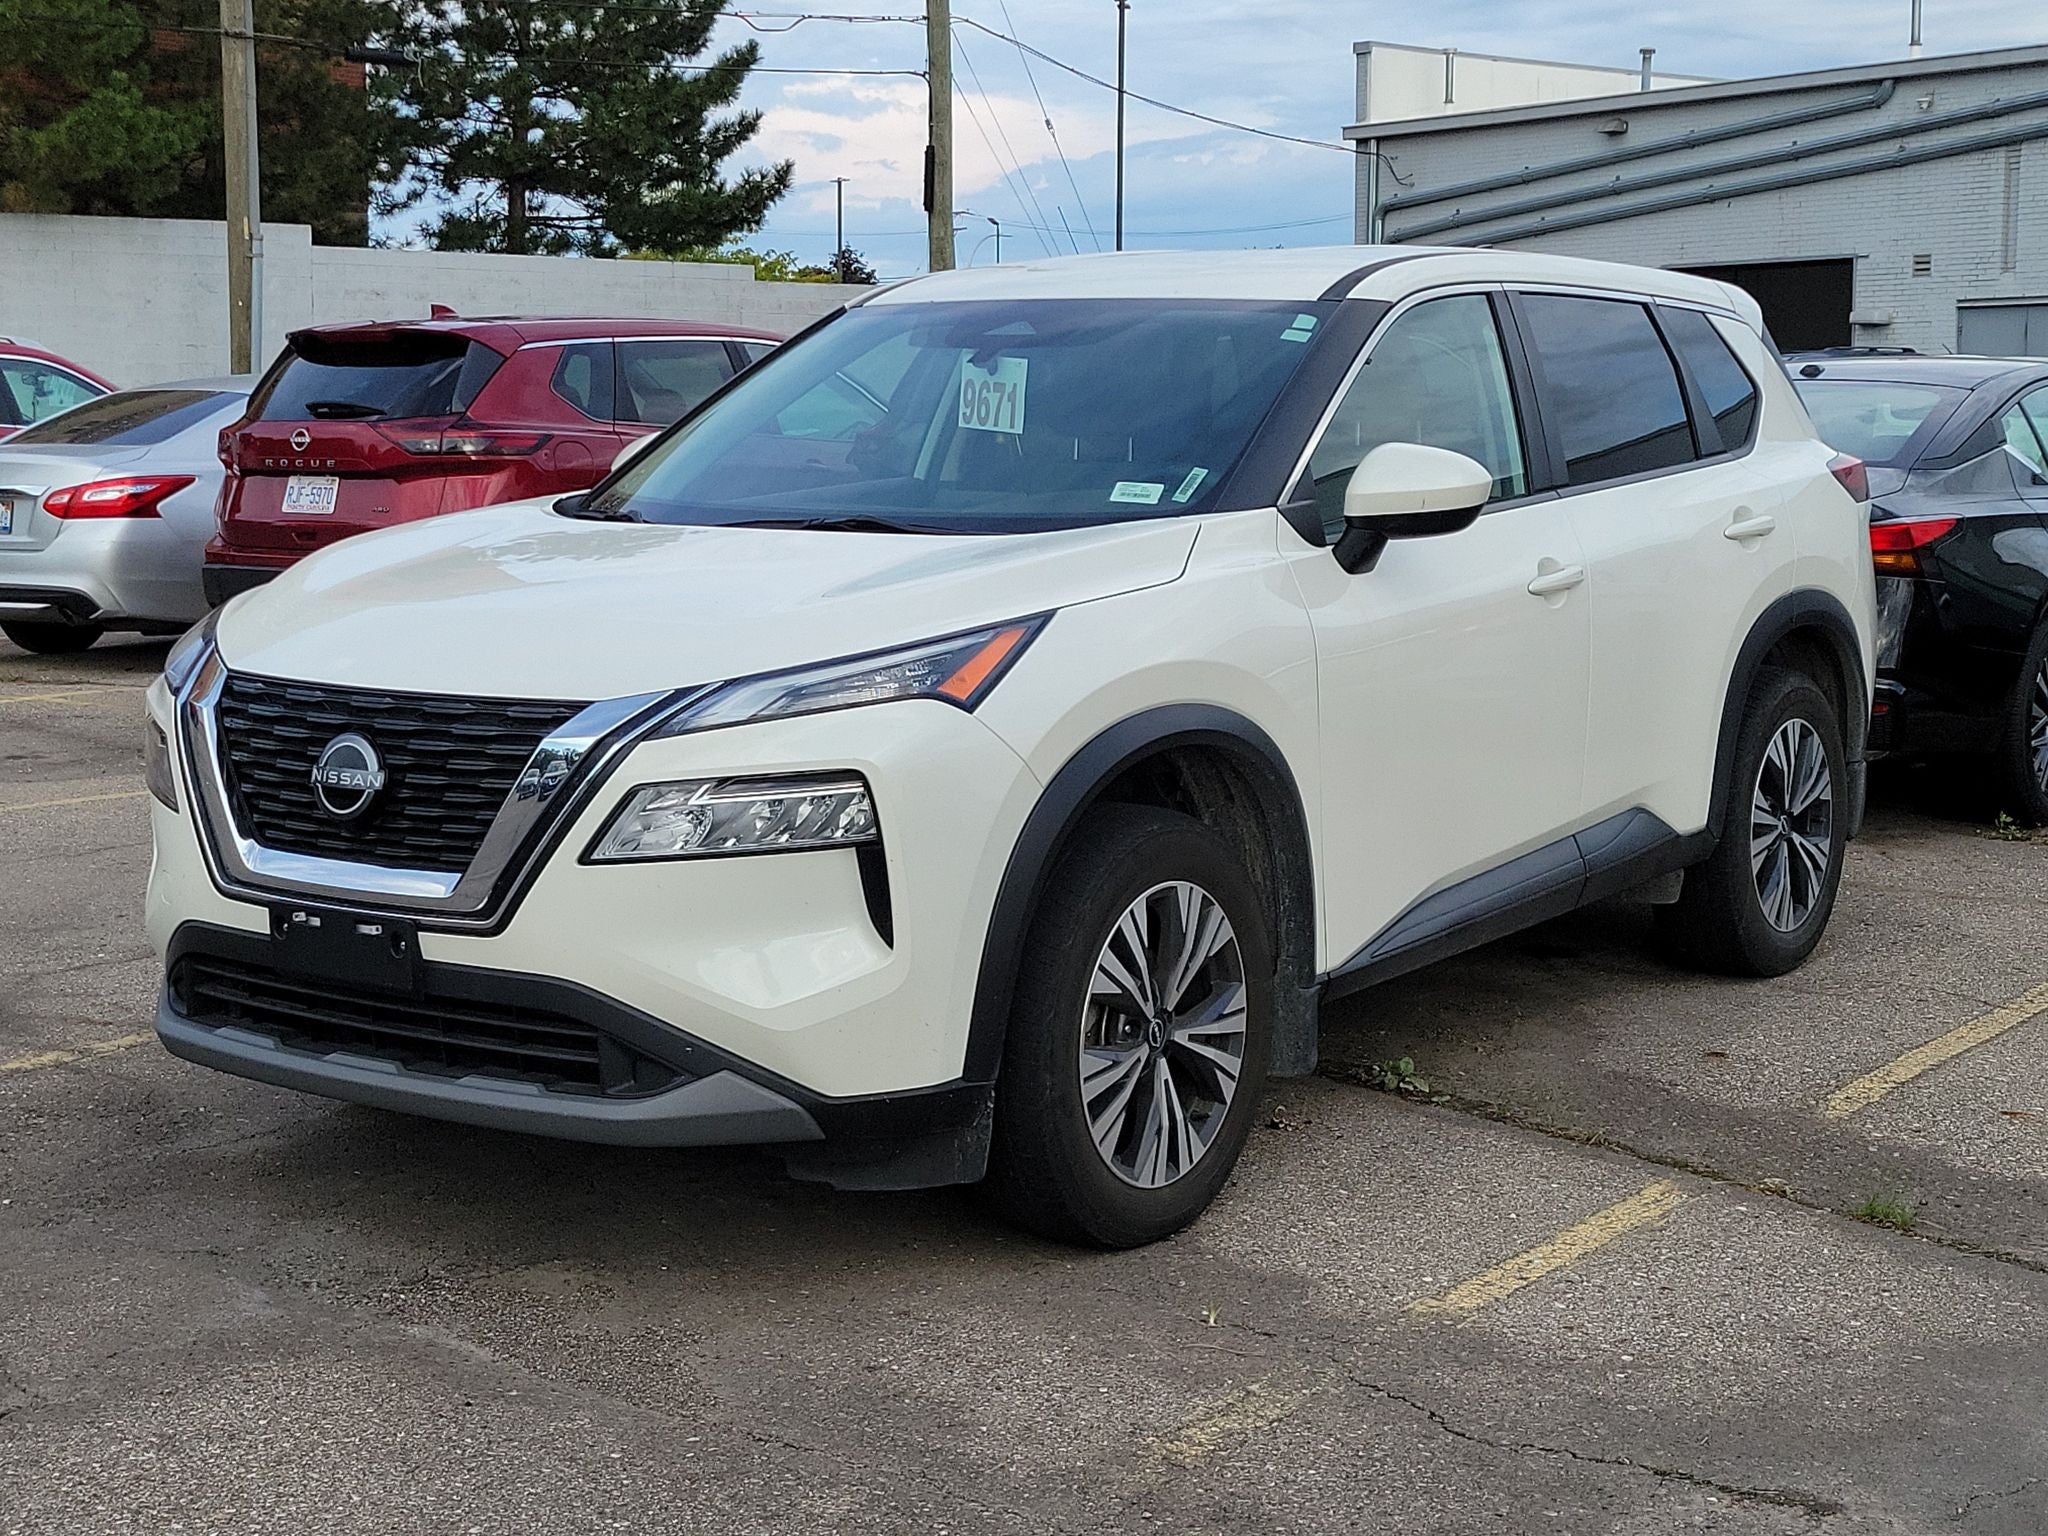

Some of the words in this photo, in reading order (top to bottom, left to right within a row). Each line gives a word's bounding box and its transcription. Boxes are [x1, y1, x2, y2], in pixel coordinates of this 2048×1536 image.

[962, 378, 1018, 429] 9671
[265, 459, 336, 468] ROGUE
[286, 486, 334, 505] RJF-5970
[310, 764, 381, 787] NISSAN
